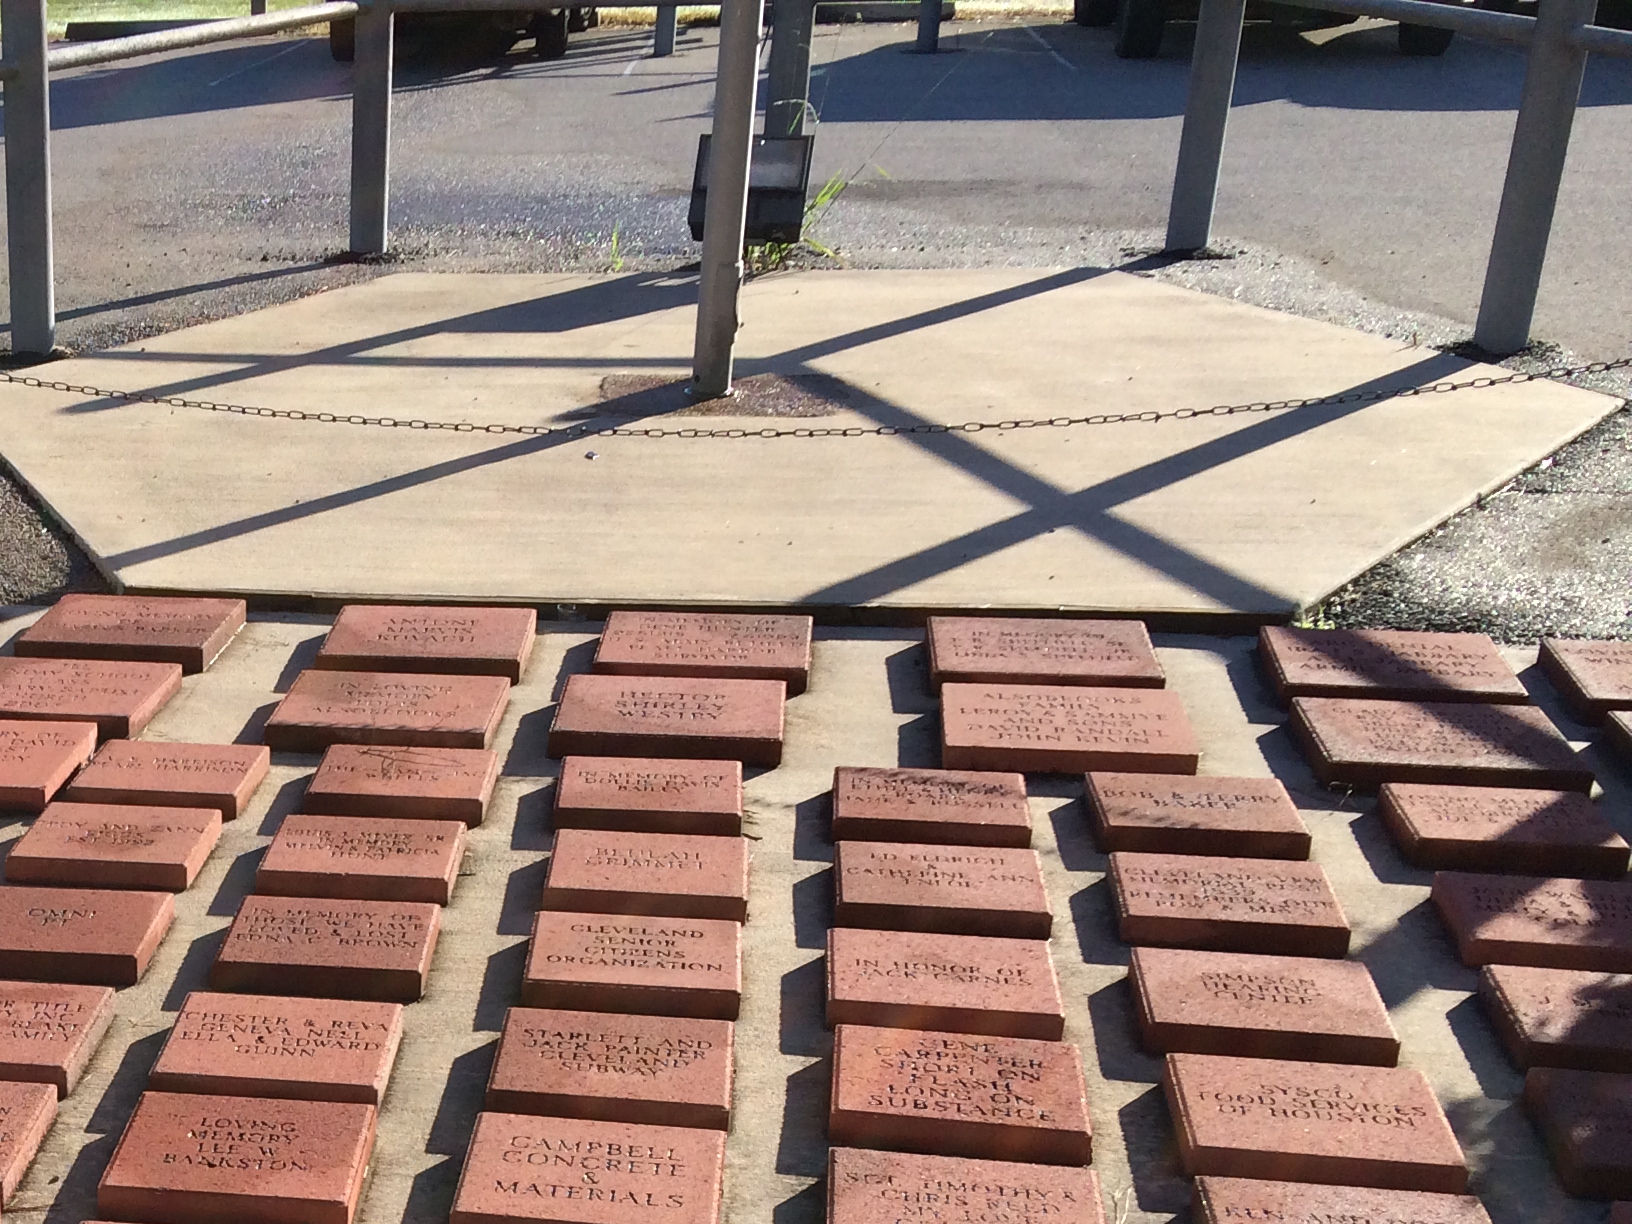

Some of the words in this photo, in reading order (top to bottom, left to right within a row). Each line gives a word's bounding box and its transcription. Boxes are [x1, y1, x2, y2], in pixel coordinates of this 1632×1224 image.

[571, 925, 704, 938] CLEVELAND
[593, 936, 677, 948] SENIOR
[546, 955, 722, 972] ORGANIZATION
[523, 1039, 588, 1051] JACK
[606, 1044, 706, 1059] PAINTER
[657, 1038, 713, 1050] AND
[540, 1050, 691, 1069] CLEVELAND
[559, 1061, 665, 1077] SUBWAY
[868, 1095, 1055, 1122] SUBSTANCE
[1218, 1104, 1252, 1115] OF
[1269, 1108, 1416, 1127] HOUSTON
[1292, 1098, 1427, 1117] SERVICES
[201, 1117, 297, 1133] LOVING
[189, 1129, 301, 1145] MEMORY
[198, 1142, 242, 1155] LEE
[510, 1135, 684, 1162] CAMPBELL
[162, 1153, 309, 1172] BANKSTON
[502, 1151, 686, 1178] CONCRETE
[581, 1171, 599, 1184] &
[494, 1179, 685, 1209] MATERIALS
